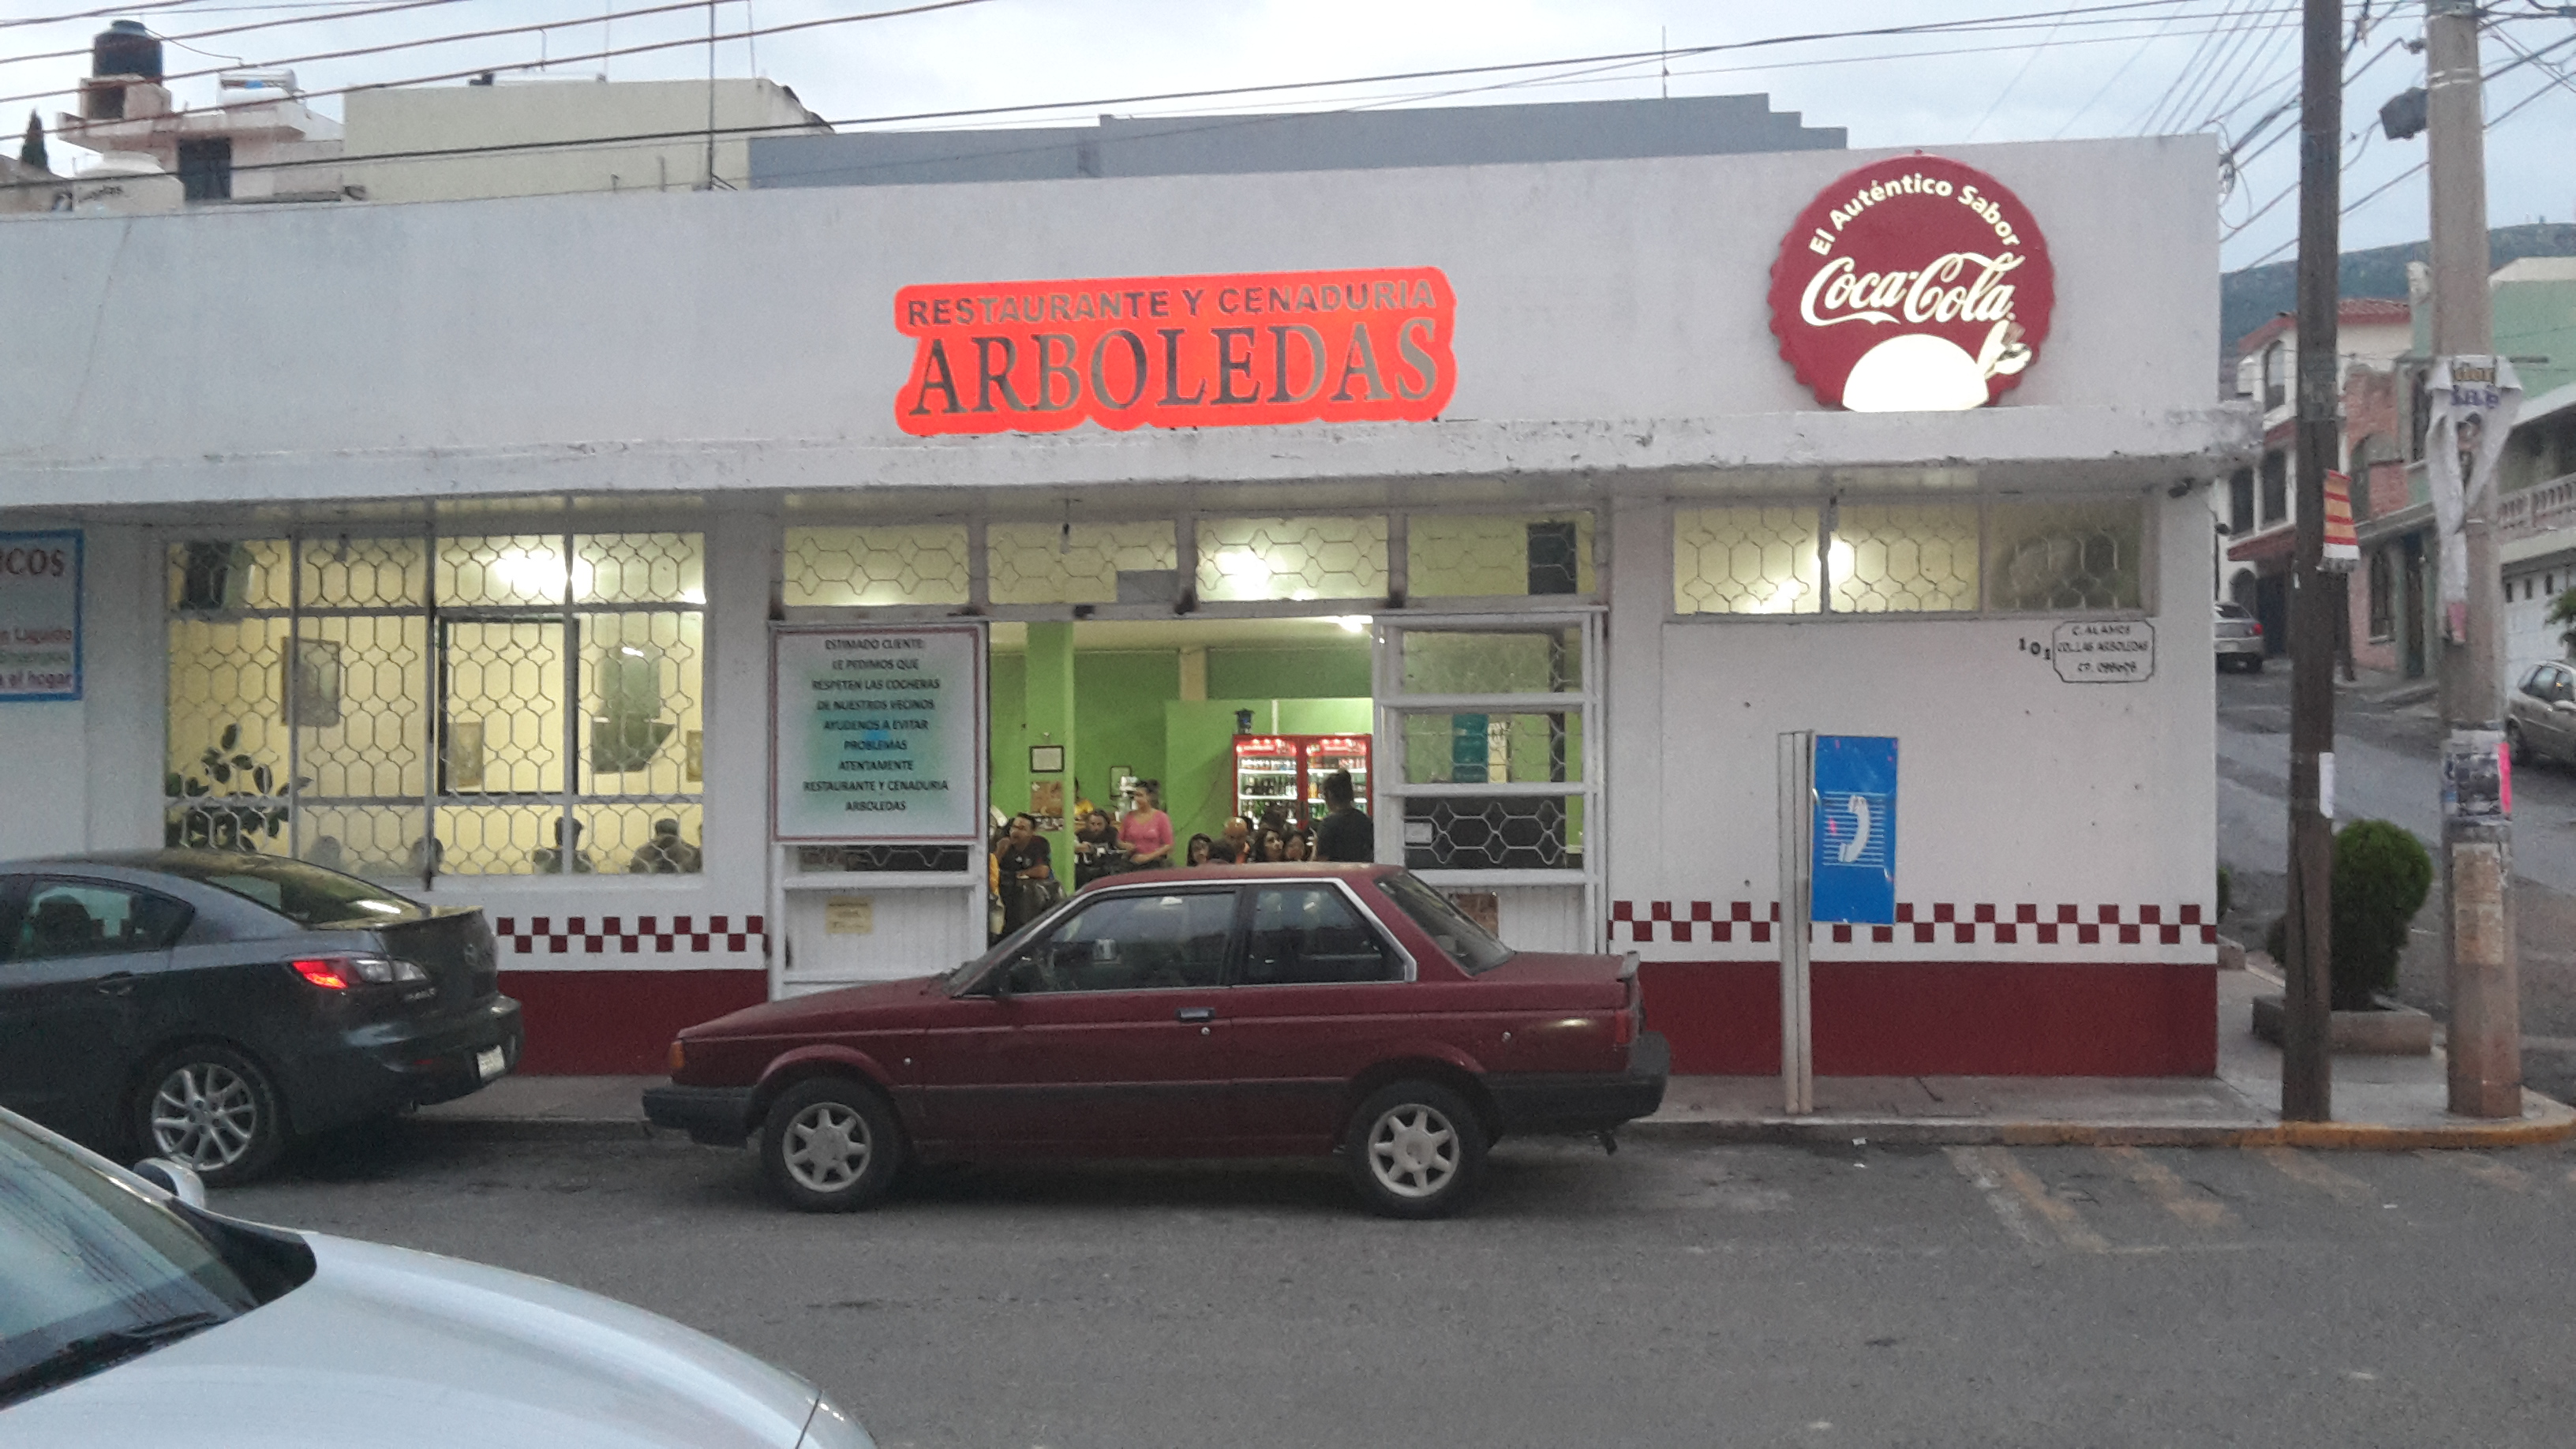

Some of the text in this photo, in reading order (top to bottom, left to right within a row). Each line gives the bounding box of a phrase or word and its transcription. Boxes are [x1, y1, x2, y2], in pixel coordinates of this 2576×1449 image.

[1809, 172, 2021, 256] El Auténtico Sabor
[1800, 252, 2027, 327] Coca-Cola
[908, 279, 1436, 326] RESTAURANTE Y CENADURIA
[908, 317, 1438, 417] ARBOLEDAS
[832, 658, 919, 670] LE PEDIMOS QUE
[811, 679, 940, 691] RESPETEN LAS COCHERAS
[833, 699, 888, 710] NUESTROS
[889, 698, 935, 710] VECINOS
[882, 719, 892, 730] A
[893, 719, 930, 731] EVITAR
[844, 739, 908, 751] PROBLEMAS
[837, 760, 914, 771] ATENTAMENTE
[878, 780, 886, 791] Y
[887, 780, 949, 792] CENADURIA
[844, 800, 906, 812] ARBOLEDAS
